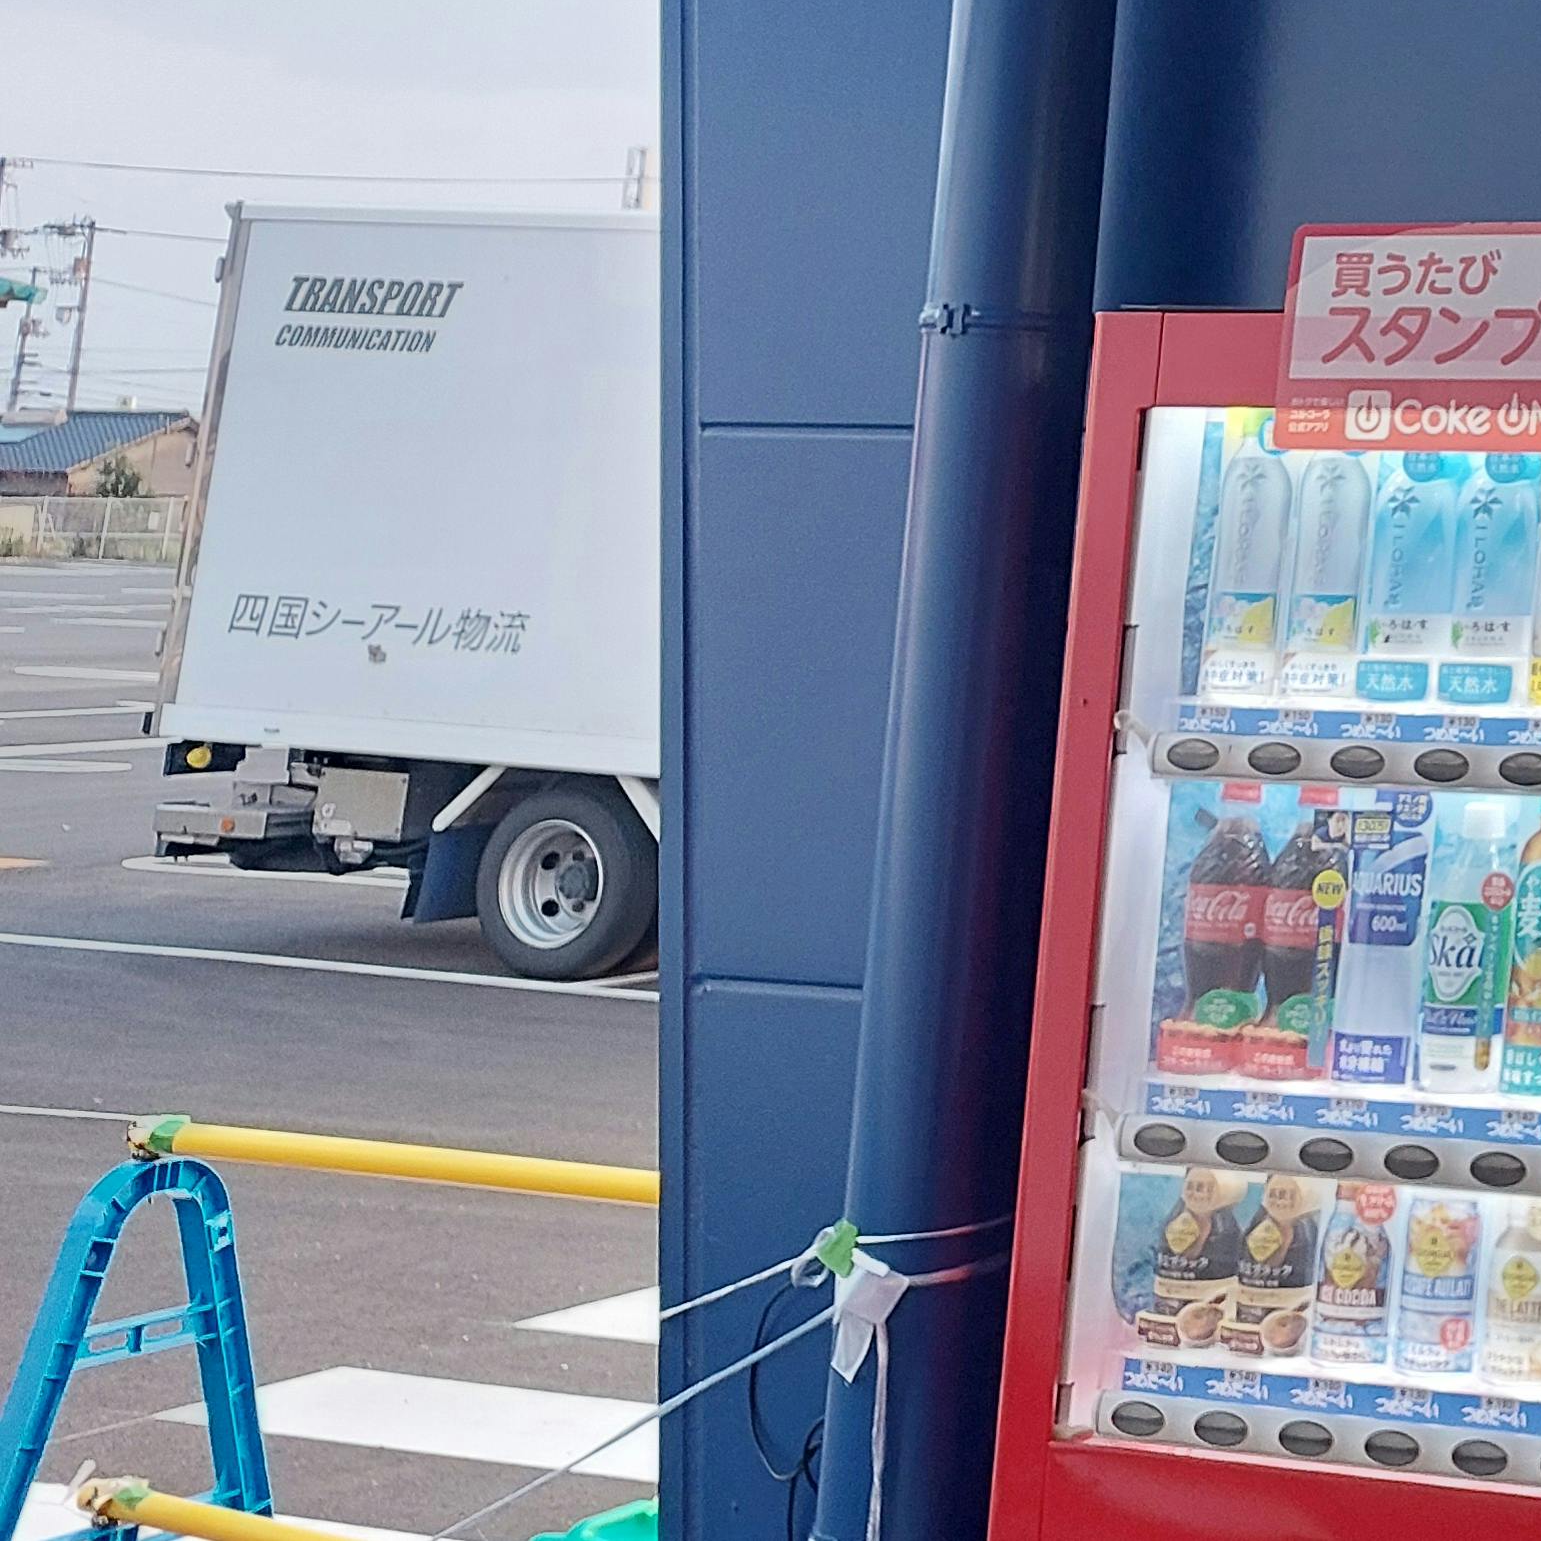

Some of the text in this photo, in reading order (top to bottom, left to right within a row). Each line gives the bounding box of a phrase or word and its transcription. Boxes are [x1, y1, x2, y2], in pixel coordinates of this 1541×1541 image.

[1331, 249, 1501, 298] 買うたび
[284, 274, 463, 318] TRANSPORT
[275, 323, 436, 353] COMMUNICATION
[1394, 398, 1490, 436] Coke
[228, 594, 530, 654] 四国シーアール物流
[1366, 673, 1414, 693] 天然水
[1448, 675, 1498, 694] 天然水
[1317, 880, 1344, 895] NEW
